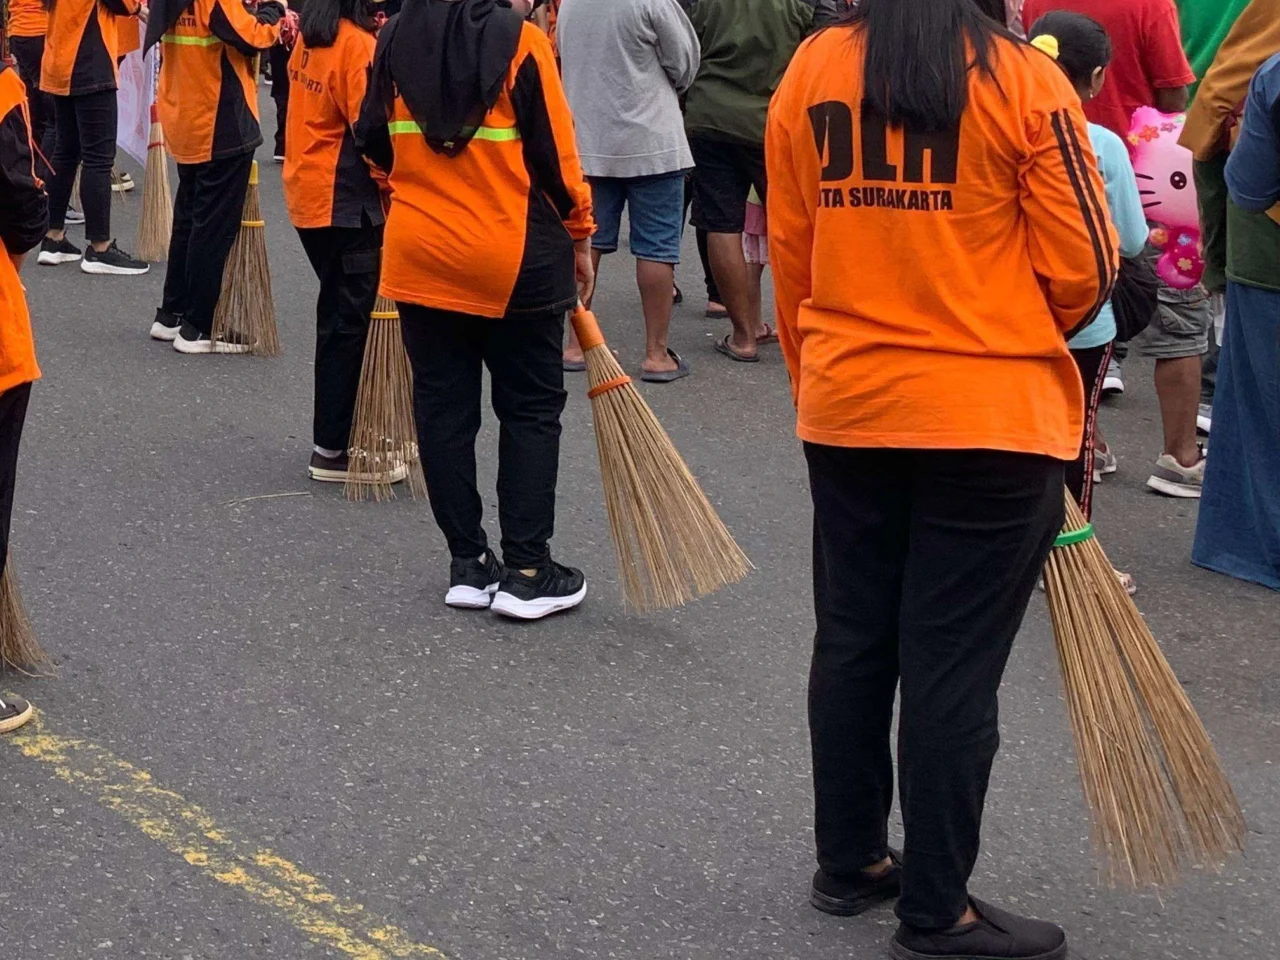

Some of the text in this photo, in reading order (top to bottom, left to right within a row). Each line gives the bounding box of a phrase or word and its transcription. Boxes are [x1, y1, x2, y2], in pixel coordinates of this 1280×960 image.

[807, 100, 961, 184] DLH
[817, 187, 953, 211] TA SURAKARTA
